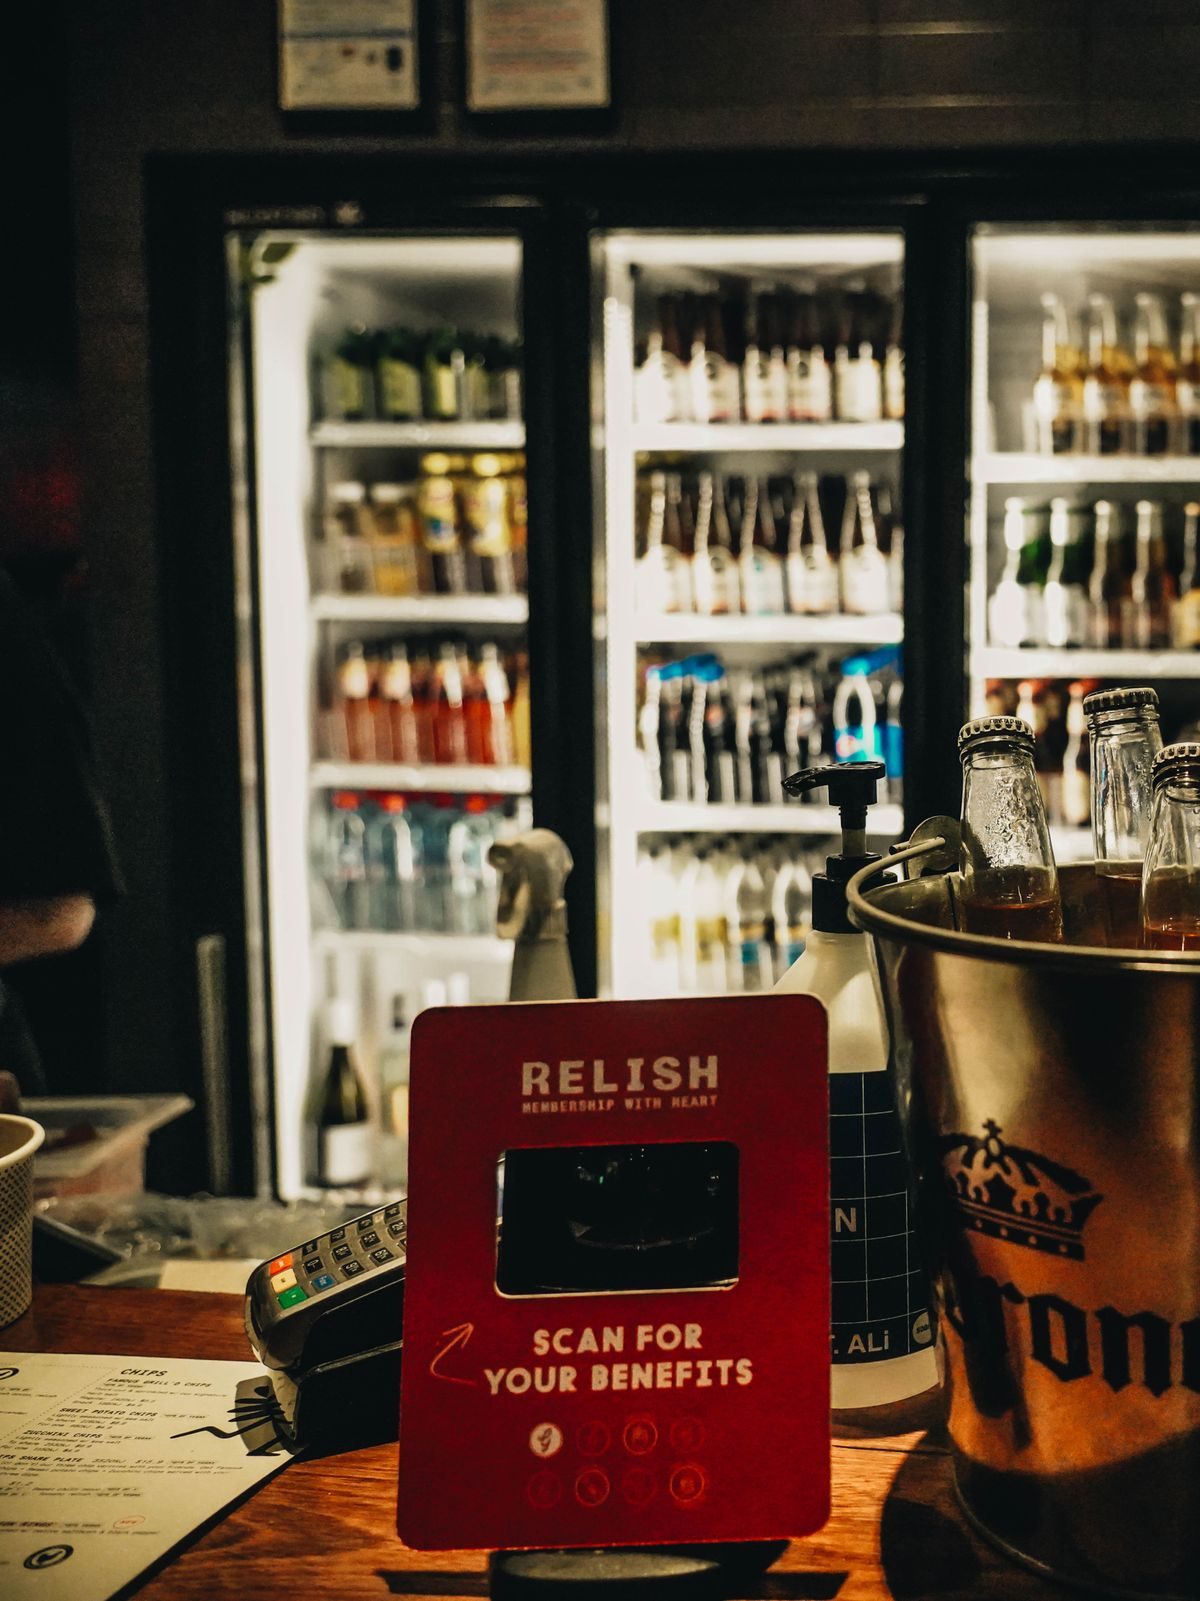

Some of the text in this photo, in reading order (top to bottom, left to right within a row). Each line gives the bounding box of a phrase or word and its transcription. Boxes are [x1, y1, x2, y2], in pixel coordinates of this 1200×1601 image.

[522, 1055, 718, 1096] RELISH
[522, 1094, 718, 1113] MEMBERSHIP WITH HEART
[533, 1323, 703, 1356] SCAN FOR
[120, 1368, 168, 1377] CHIPS
[483, 1358, 753, 1395] YOUR BENEFITS
